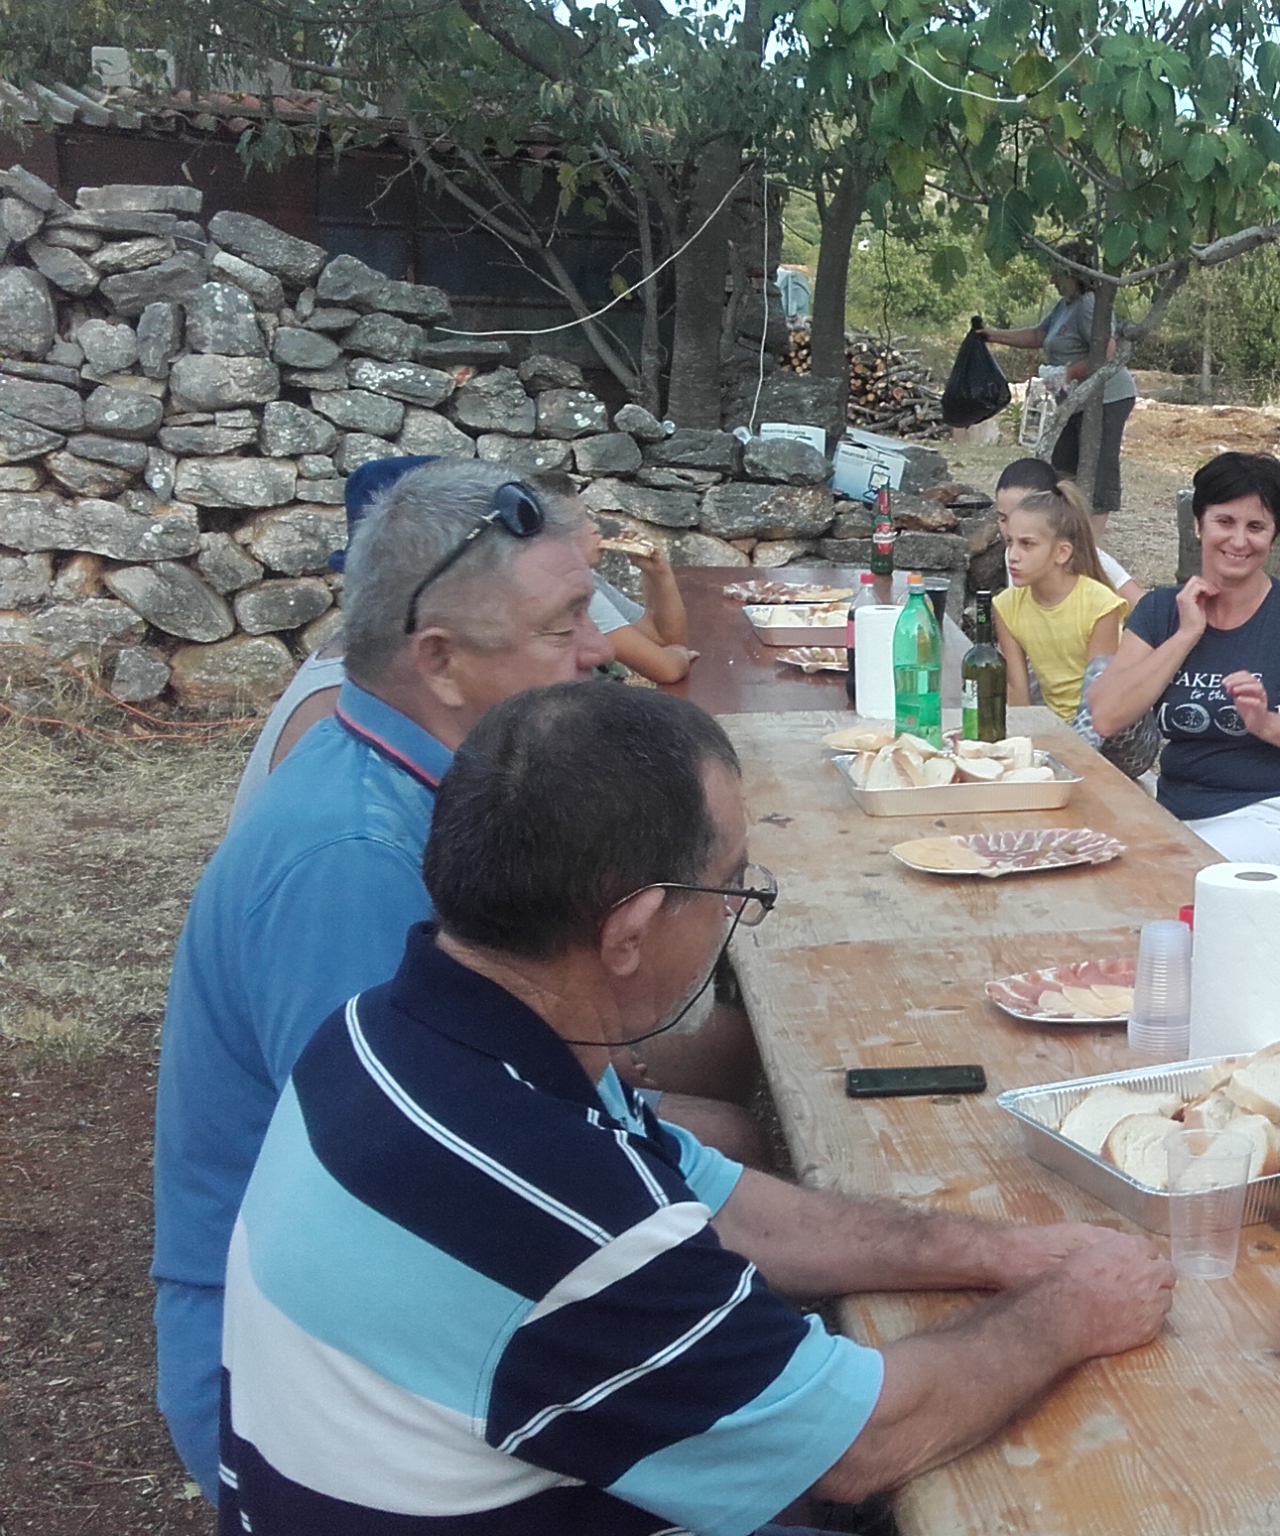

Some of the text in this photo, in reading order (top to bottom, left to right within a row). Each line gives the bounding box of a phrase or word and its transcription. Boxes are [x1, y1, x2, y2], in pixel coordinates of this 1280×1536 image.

[1176, 671, 1223, 688] AKE
[1190, 688, 1227, 701] to the
